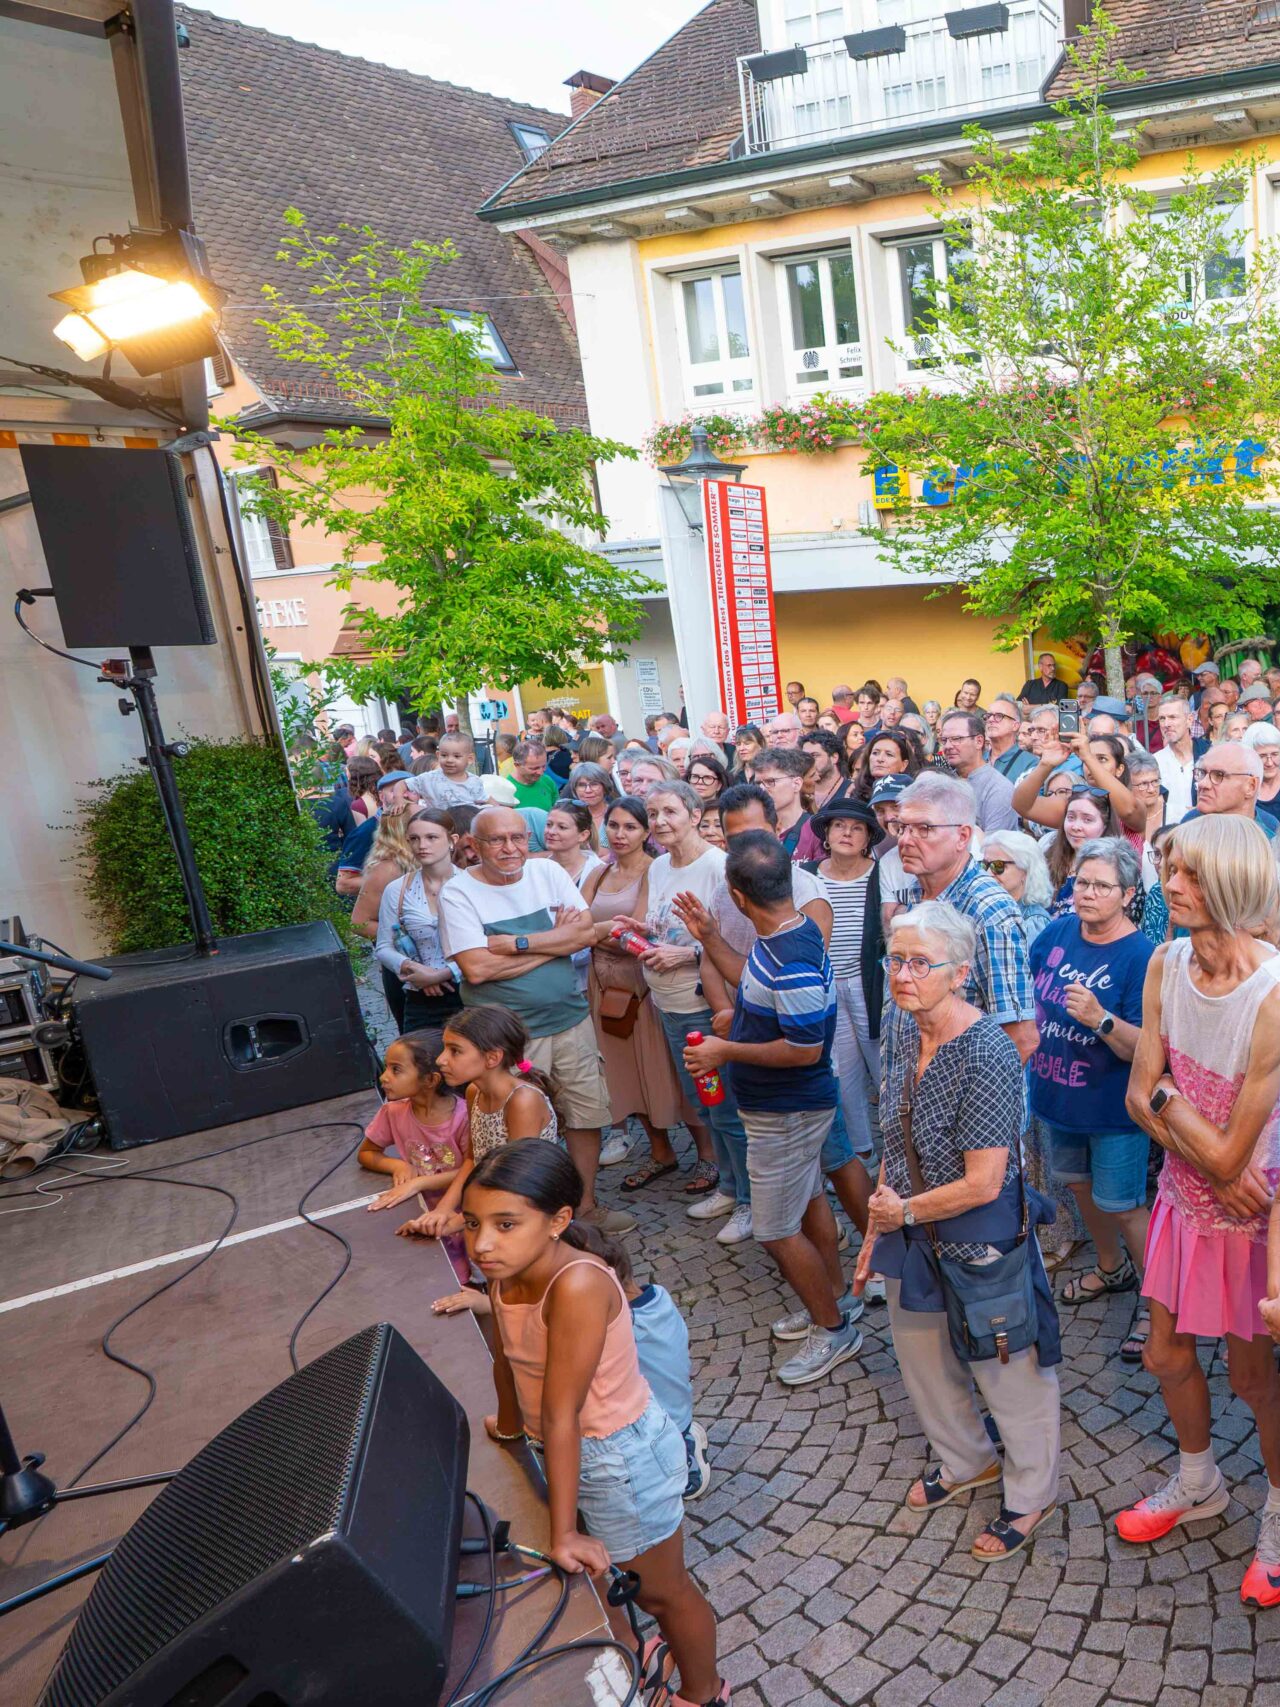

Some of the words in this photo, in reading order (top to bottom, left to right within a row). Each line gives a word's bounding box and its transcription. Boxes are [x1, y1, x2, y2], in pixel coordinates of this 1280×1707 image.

[720, 607, 729, 647] Jazzfest
[725, 671, 735, 730] unterstützen
[1059, 963, 1114, 989] coole
[1041, 1020, 1096, 1045] spielen
